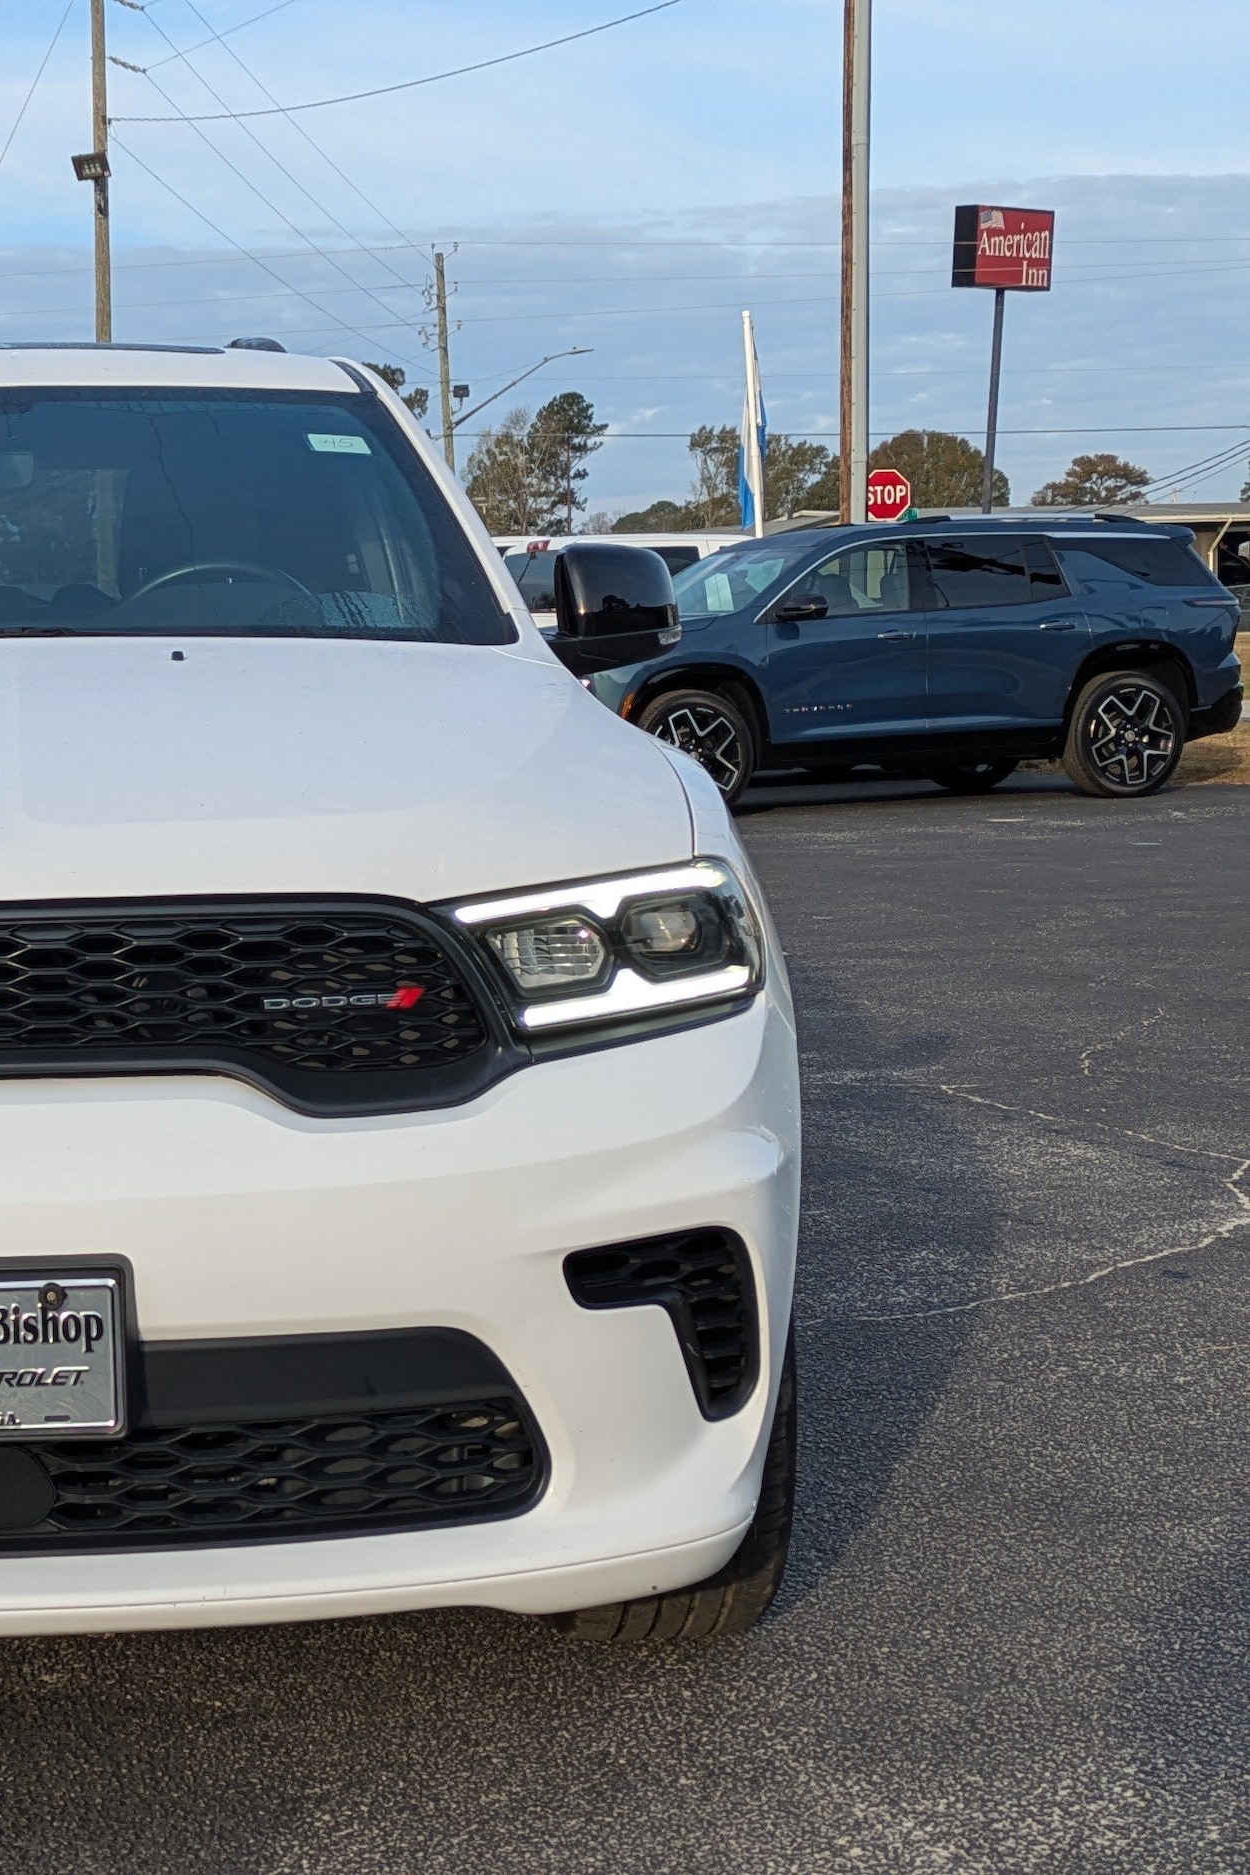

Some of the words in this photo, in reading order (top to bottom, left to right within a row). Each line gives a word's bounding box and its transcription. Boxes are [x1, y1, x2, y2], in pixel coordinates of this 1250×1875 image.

[977, 222, 1050, 259] American
[1021, 260, 1048, 287] Inn
[867, 485, 907, 505] STOP
[263, 993, 400, 1010] DODGE
